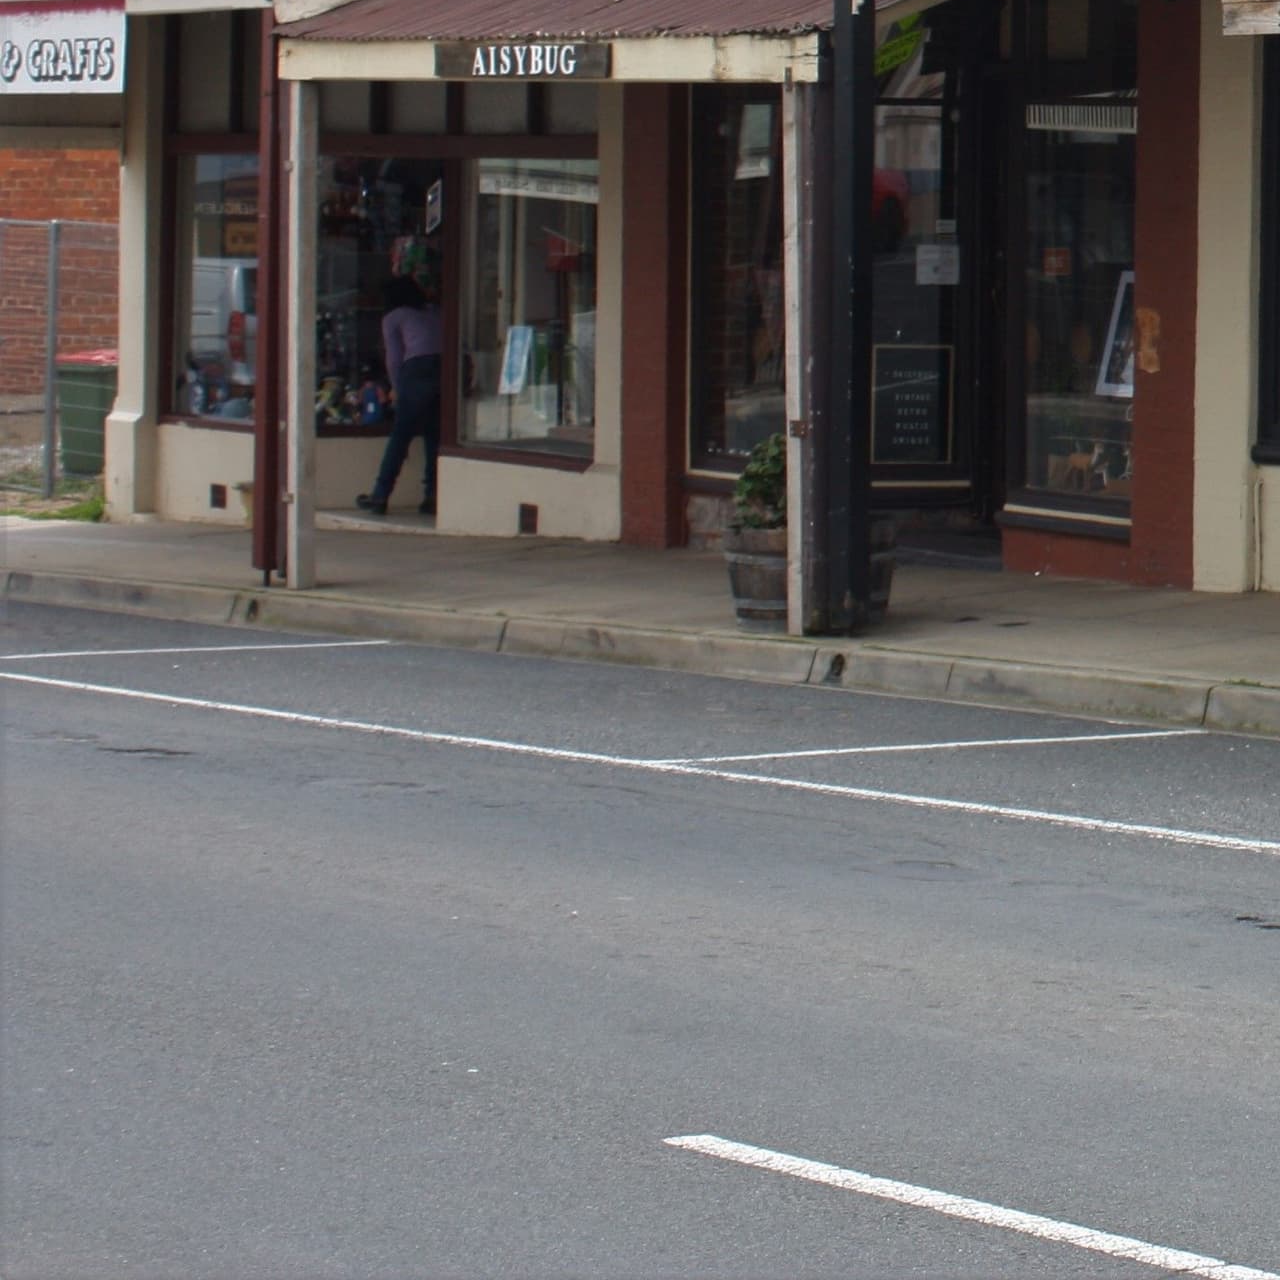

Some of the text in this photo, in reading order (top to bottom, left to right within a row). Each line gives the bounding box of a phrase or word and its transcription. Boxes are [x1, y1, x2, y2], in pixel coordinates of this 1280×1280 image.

[1, 37, 115, 82] & CRAFTS
[472, 44, 577, 76] AISYBUG
